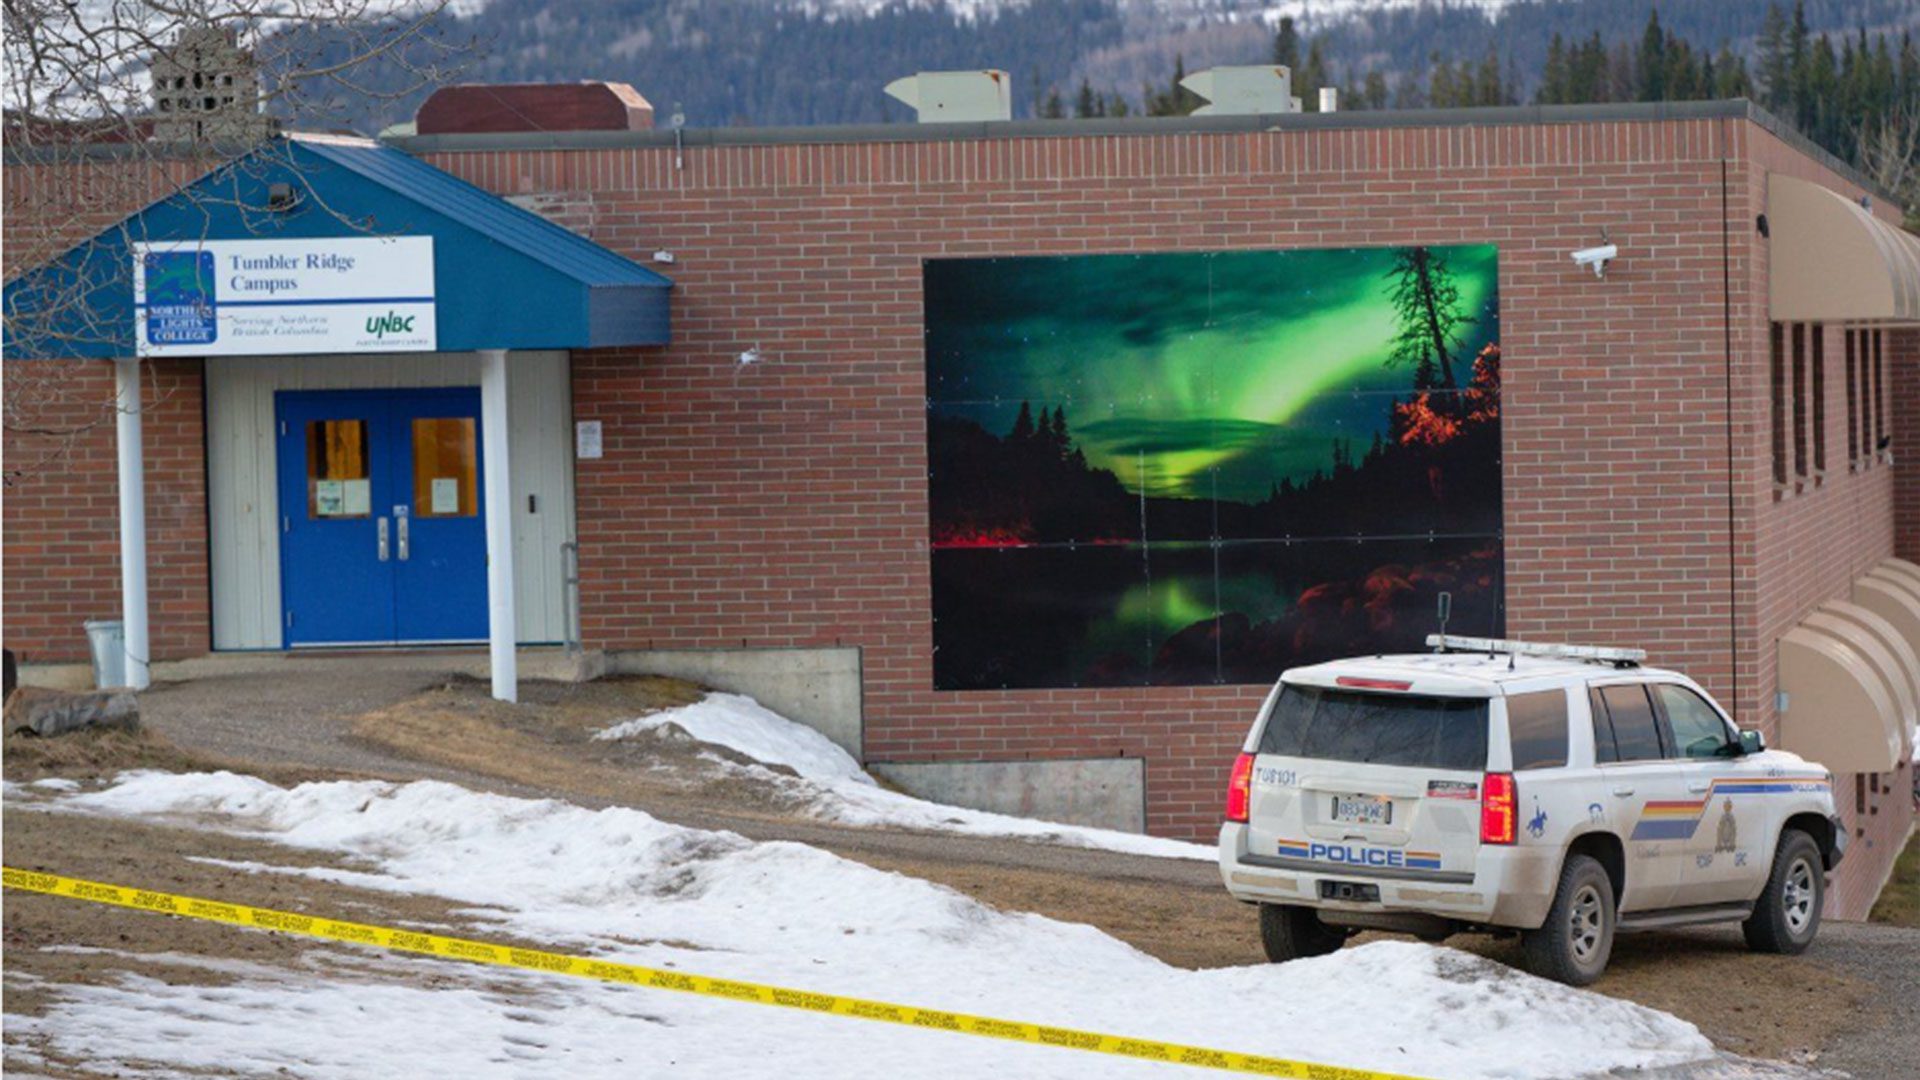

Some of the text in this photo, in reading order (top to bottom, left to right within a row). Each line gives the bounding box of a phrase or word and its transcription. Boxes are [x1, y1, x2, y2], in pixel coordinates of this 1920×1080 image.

[229, 253, 356, 272] Tumbler Ridge
[230, 275, 299, 294] Campus
[366, 310, 416, 339] UNBC
[154, 330, 209, 341] COLLEGE
[1310, 843, 1404, 866] POLICE
